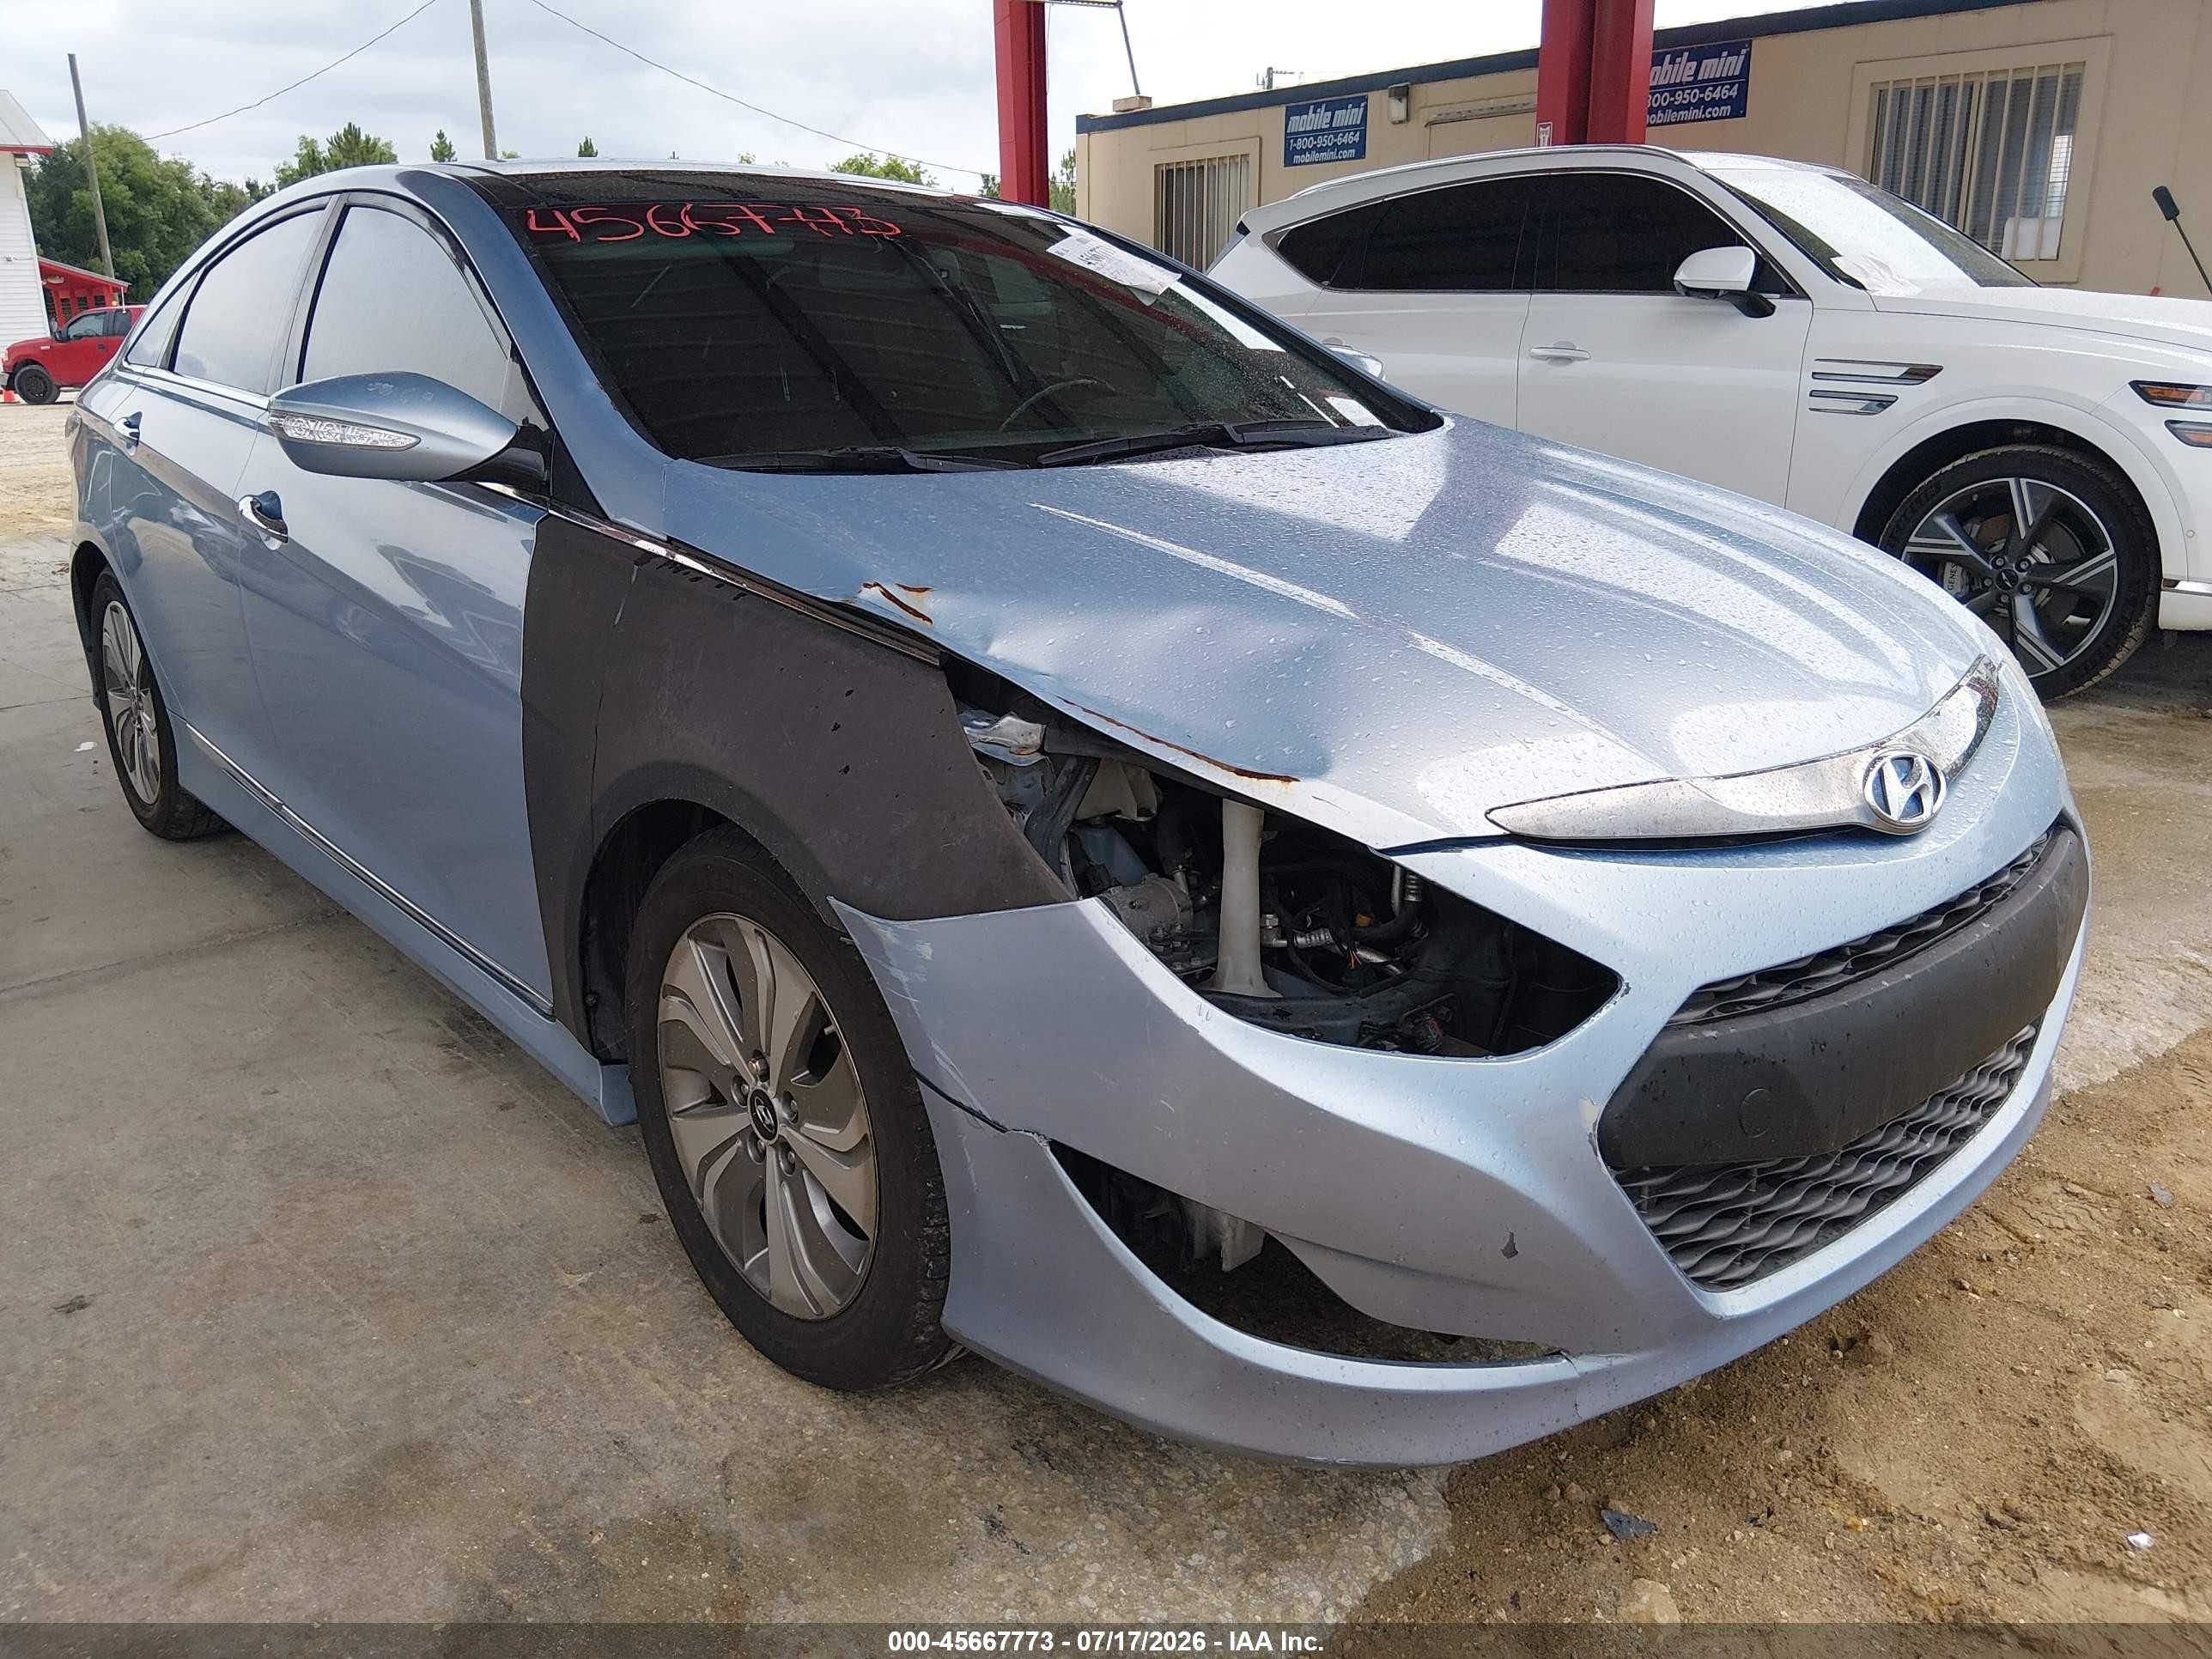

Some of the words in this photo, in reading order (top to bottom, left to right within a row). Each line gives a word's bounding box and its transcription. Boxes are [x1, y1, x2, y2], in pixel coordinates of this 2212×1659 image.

[1649, 52, 1698, 86] obile
[1698, 49, 1747, 81] mini
[1286, 104, 1332, 133] mobile
[1332, 102, 1365, 128] mini
[1290, 131, 1360, 151] 1-800-950-6464
[1292, 148, 1356, 164] mobilemini.com
